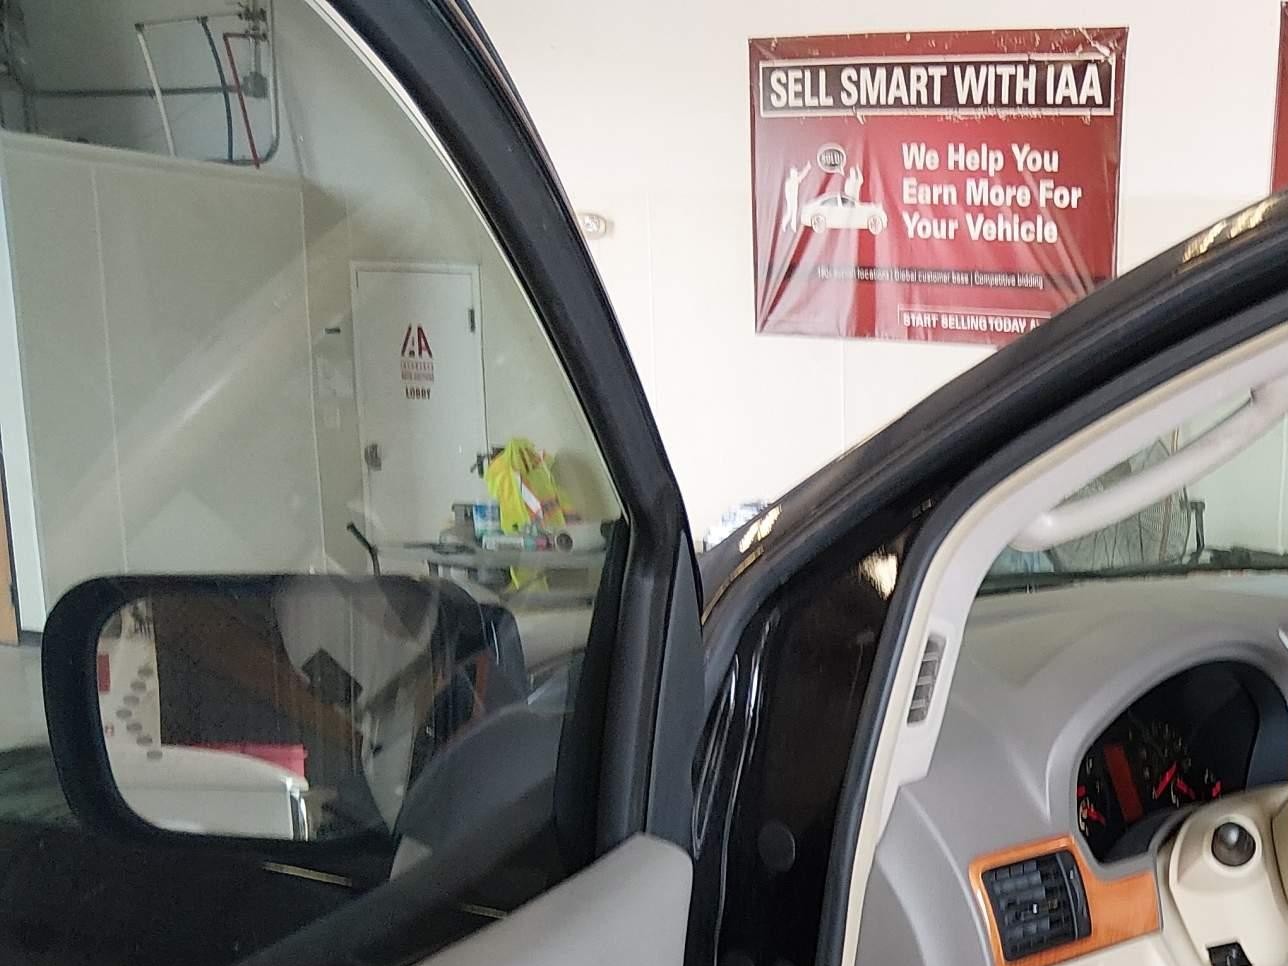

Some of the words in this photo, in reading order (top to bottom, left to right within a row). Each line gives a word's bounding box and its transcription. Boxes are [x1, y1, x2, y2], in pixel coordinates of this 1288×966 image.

[770, 67, 834, 108] SELL
[840, 65, 948, 107] SMART
[953, 63, 1037, 106] WITH
[1046, 62, 1104, 106] IAA
[902, 142, 940, 171] We
[947, 142, 1005, 177] Help
[1011, 142, 1060, 173] You
[903, 176, 958, 206] Earn
[965, 177, 1032, 208] More
[1039, 178, 1083, 209] For
[902, 210, 959, 240] Your
[965, 212, 1058, 244] Vehicle
[895, 267, 917, 283] Global
[918, 270, 950, 284] customer
[951, 270, 969, 285] base
[974, 270, 1016, 288] Competitive
[1017, 272, 1044, 290] bidding
[903, 311, 938, 328] START
[940, 313, 988, 332] SELLING
[988, 315, 1027, 334] TODAY
